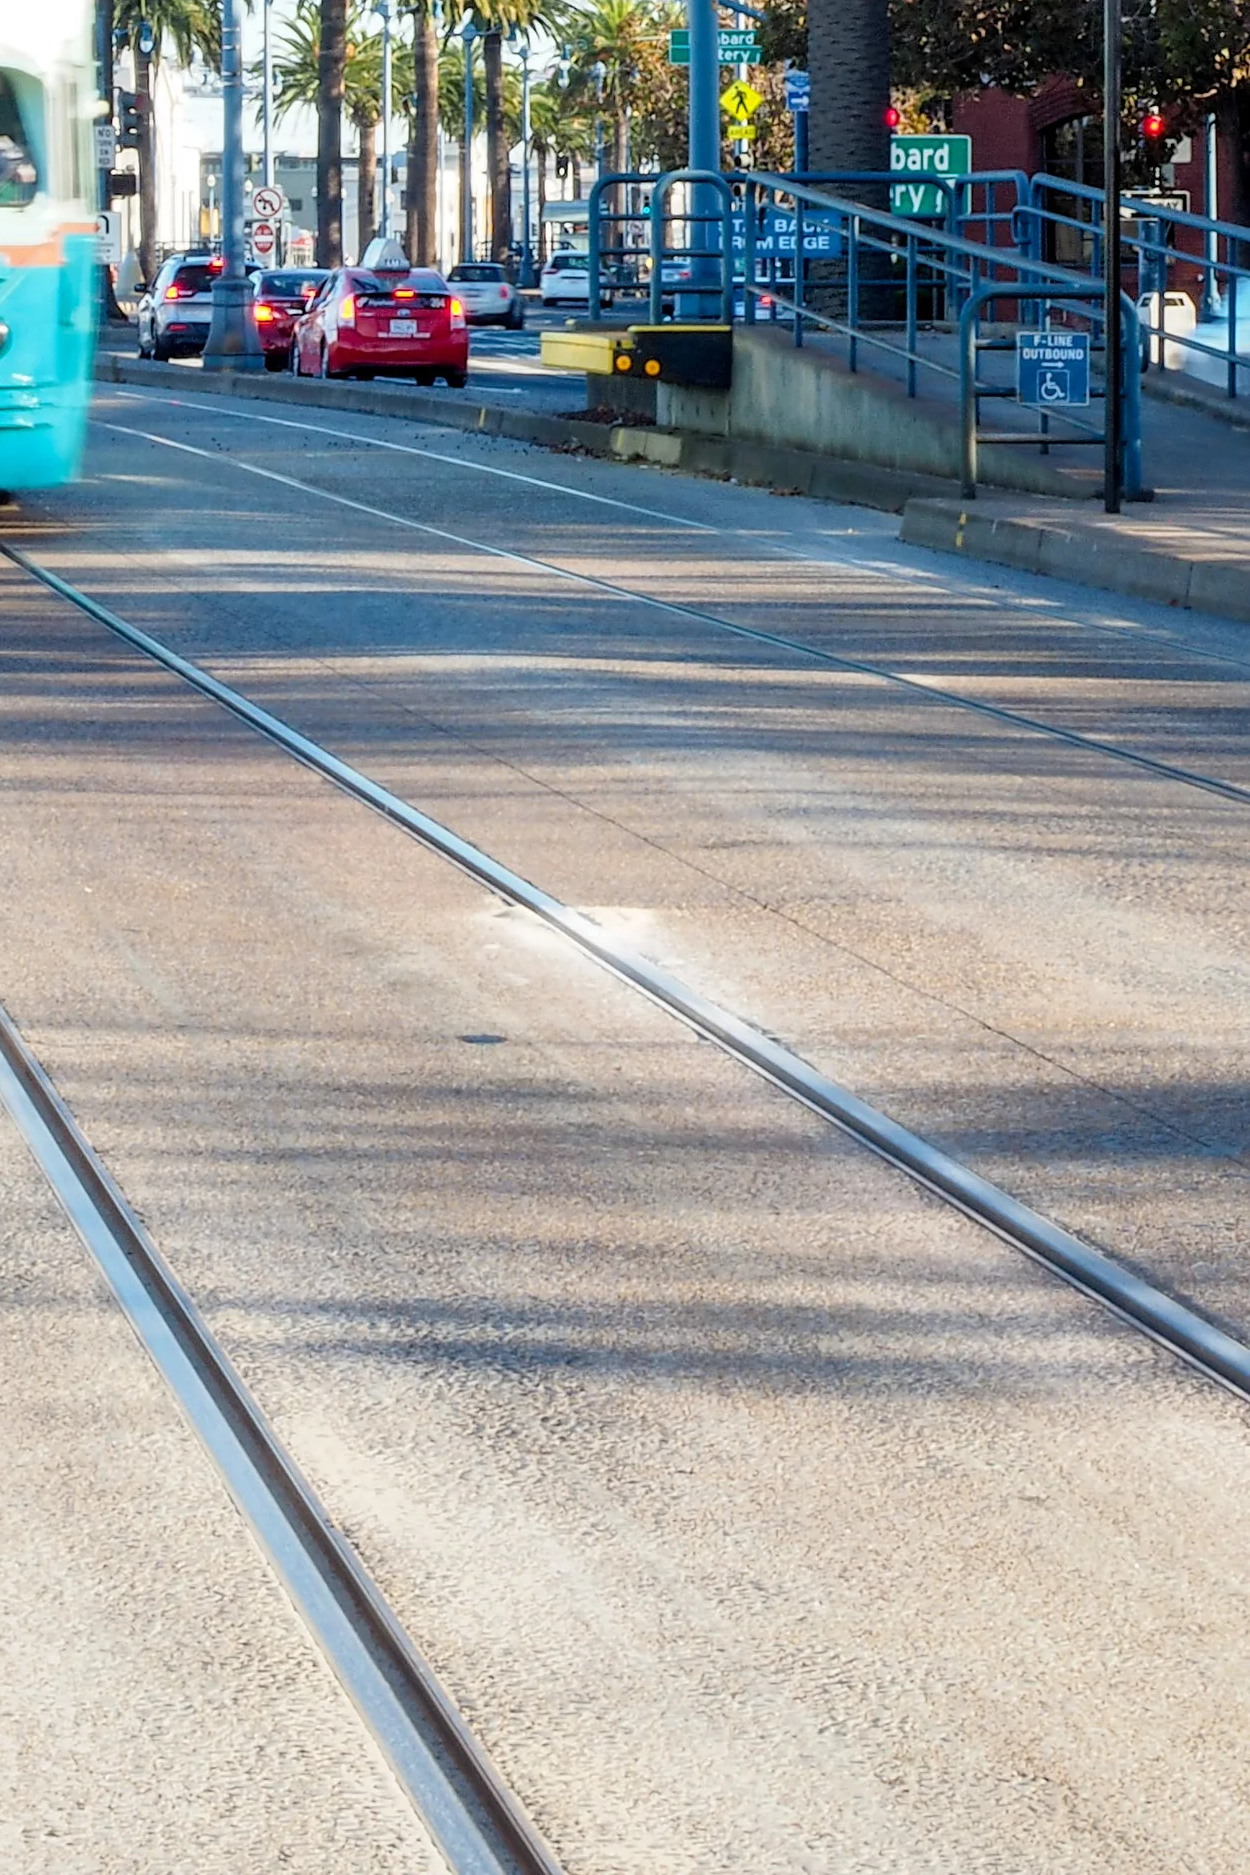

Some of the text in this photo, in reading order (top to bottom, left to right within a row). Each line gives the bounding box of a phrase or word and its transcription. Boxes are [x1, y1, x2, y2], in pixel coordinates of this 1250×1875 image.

[718, 32, 755, 44] bard
[718, 49, 750, 63] tery
[889, 184, 925, 213] ry
[1033, 335, 1073, 346] F-LINE
[1022, 348, 1084, 360] OUTBOUND
